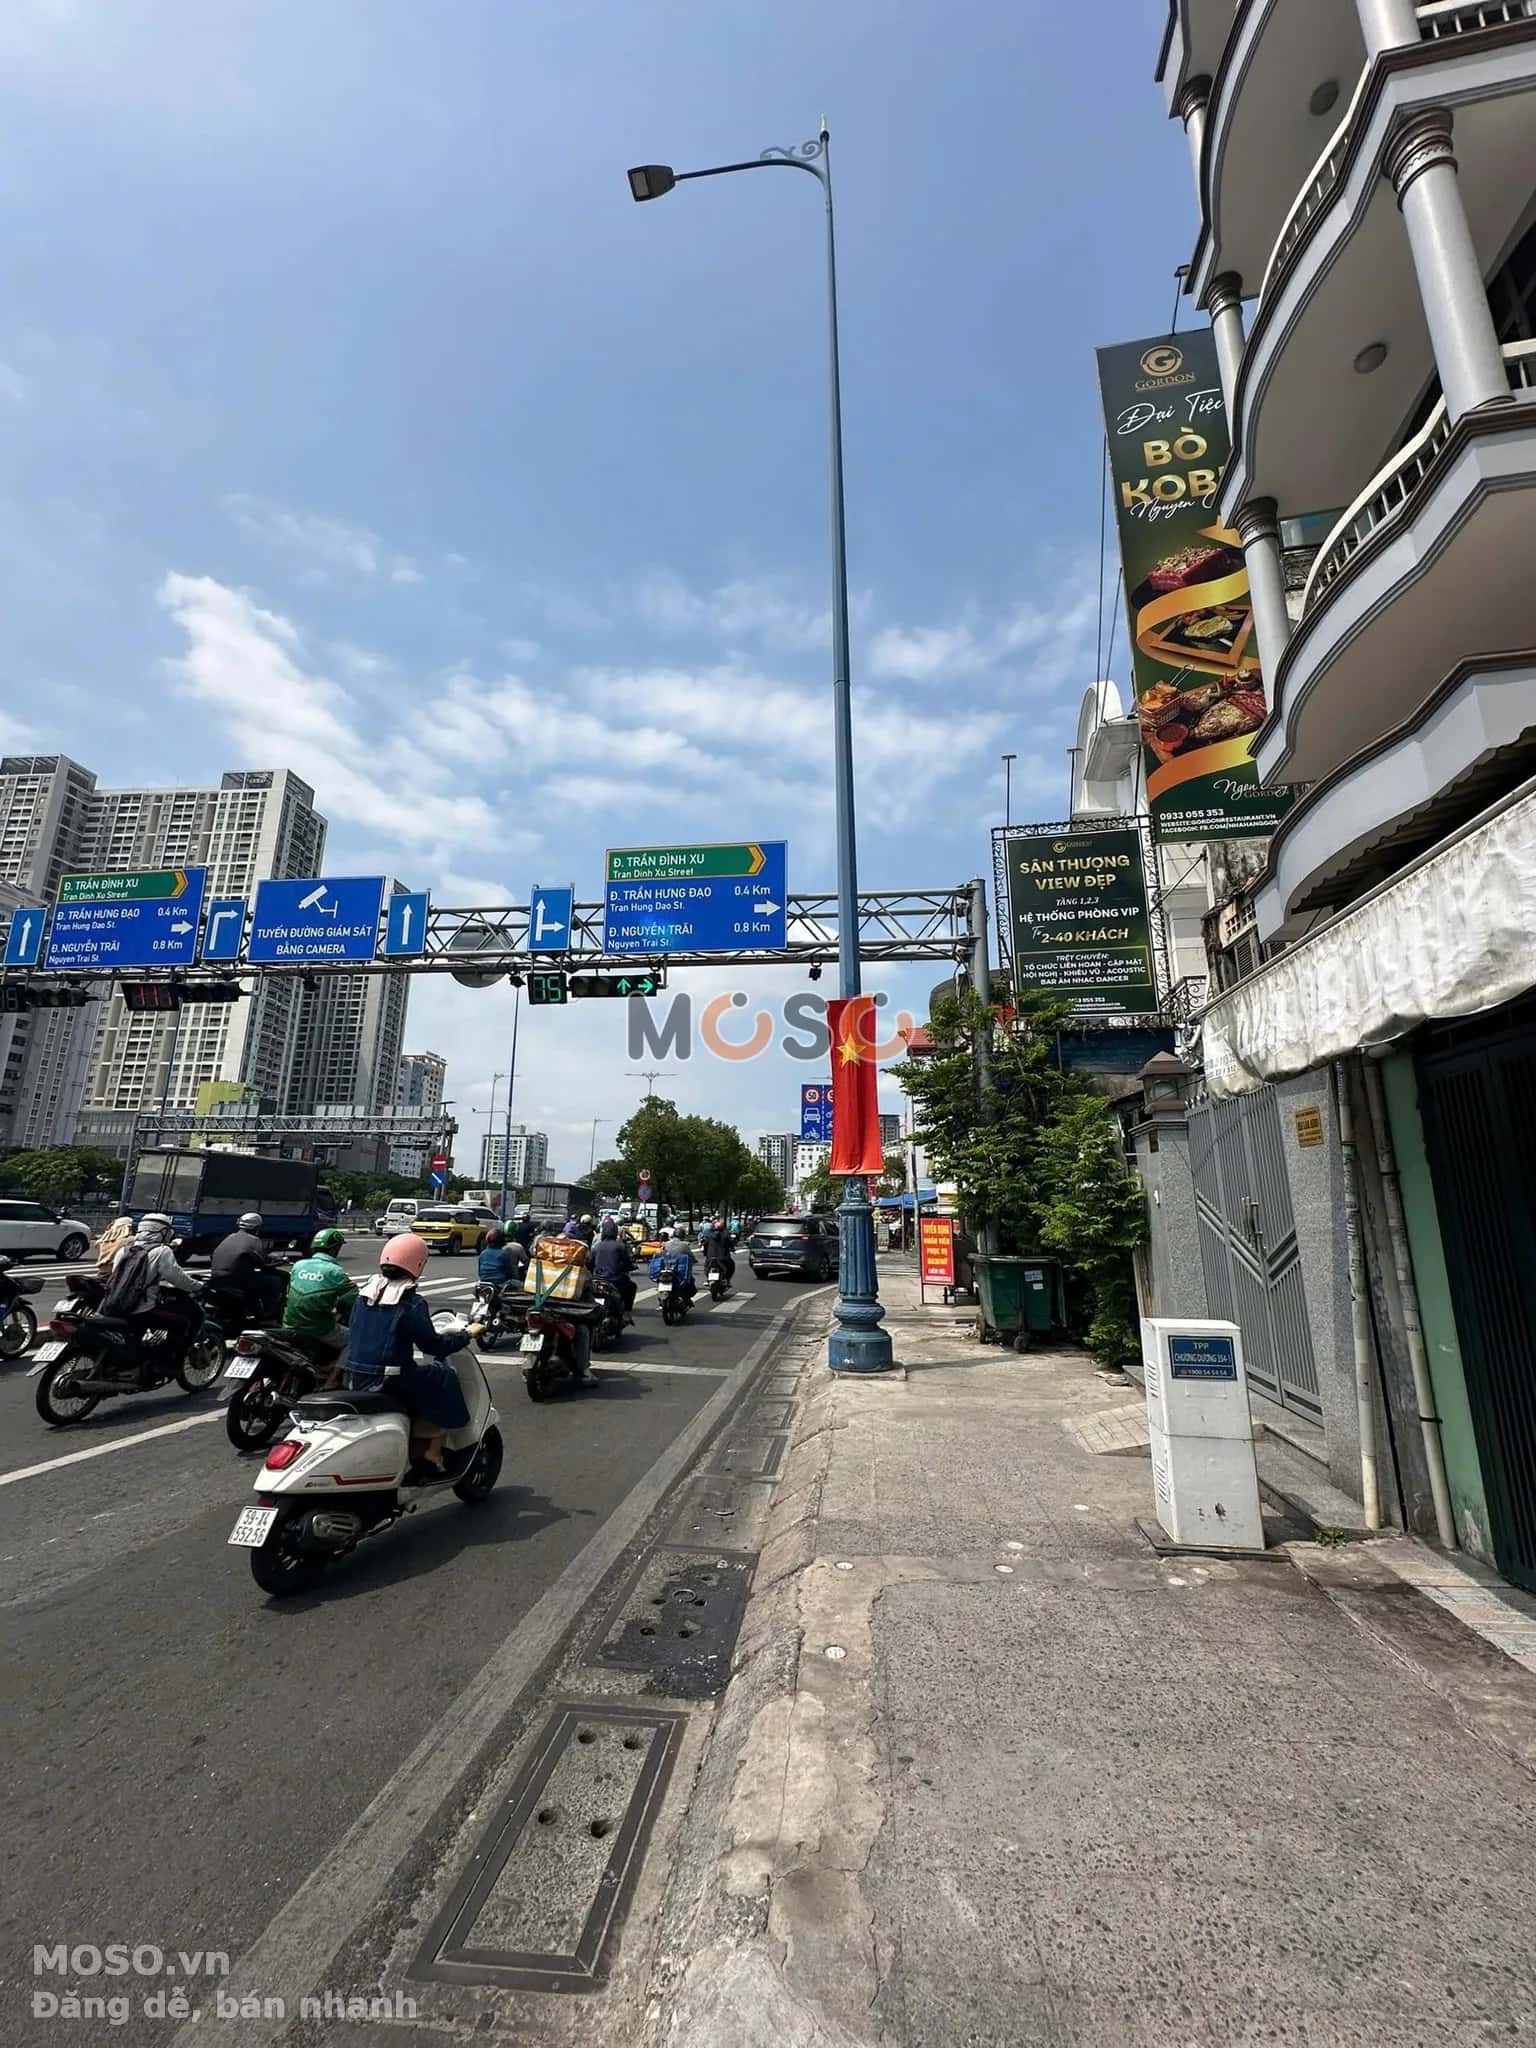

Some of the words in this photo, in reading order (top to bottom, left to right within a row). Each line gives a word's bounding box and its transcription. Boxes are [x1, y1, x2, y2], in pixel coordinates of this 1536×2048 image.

[1135, 372, 1196, 389] GORDON
[1117, 403, 1175, 434] Đại
[1143, 426, 1207, 467] BÒ
[1121, 466, 1224, 508] KOB
[1159, 812, 1184, 821] 0933
[1186, 810, 1204, 819] 055
[1206, 808, 1224, 817] 353
[613, 858, 624, 868] Đ.
[627, 853, 656, 867] TRẦN
[659, 853, 687, 866] ĐÌNH
[689, 853, 704, 864] XU
[1020, 859, 1054, 874] SÂN
[1057, 855, 1130, 872] THƯỢNG
[613, 870, 632, 879] Tran
[634, 869, 653, 878] Dinh
[655, 869, 666, 877] Xu
[668, 867, 693, 876] Street
[64, 881, 73, 891] Đ.
[76, 879, 100, 890] TRẦN
[101, 878, 123, 889] ĐÌNH
[126, 878, 139, 888] XU
[1035, 876, 1080, 890] VIEW
[1084, 874, 1116, 890] ĐẸP
[610, 890, 620, 900] Đ.
[623, 885, 651, 899] TRẦN
[655, 886, 686, 899] HƯNG
[689, 886, 711, 899] ĐẠO
[735, 886, 749, 896] 0.4
[753, 885, 770, 895] Km
[610, 903, 628, 912] Tran
[631, 902, 653, 912] Hung
[655, 901, 671, 910] Dao
[674, 901, 684, 910] St.
[1056, 897, 1078, 906] TẦNG
[57, 911, 65, 920] Đ.
[69, 908, 92, 920] TRẦN
[93, 908, 119, 919] HƯNG
[121, 908, 140, 919] ĐẠO
[158, 907, 170, 916] 0.4
[173, 907, 187, 916] Km
[1019, 912, 1034, 924] HỆ
[1036, 909, 1075, 922] THỐNG
[1078, 907, 1119, 919] PHÒNG
[1121, 907, 1140, 916] VIP
[72, 923, 90, 931] Hung
[257, 925, 287, 938] TUYẾN
[290, 925, 324, 938] ĐƯỜNG
[326, 924, 350, 937] GIÁM
[352, 924, 373, 937] SÁT
[609, 927, 619, 937] Đ.
[621, 921, 665, 936] NGUYỄN
[669, 923, 693, 935] TRÃI
[734, 922, 749, 933] 0.8
[753, 922, 770, 932] Km
[1041, 931, 1073, 943] 2-40
[1075, 927, 1129, 942] KHÁCH
[51, 944, 60, 953] Đ.
[61, 939, 97, 952] NGUYỄN
[100, 941, 120, 951] TRÃI
[153, 940, 165, 949] 0.8
[168, 940, 182, 949] Km
[276, 941, 303, 955] BẰNG
[305, 944, 346, 954] CAMERA
[608, 940, 639, 950] Nguyen
[642, 938, 658, 948] Trai
[660, 938, 671, 947] St.
[49, 955, 75, 965] Nguyen
[77, 954, 90, 962] Trai
[1107, 966, 1147, 974] ACOUSTIC
[298, 1270, 325, 1281] Grab
